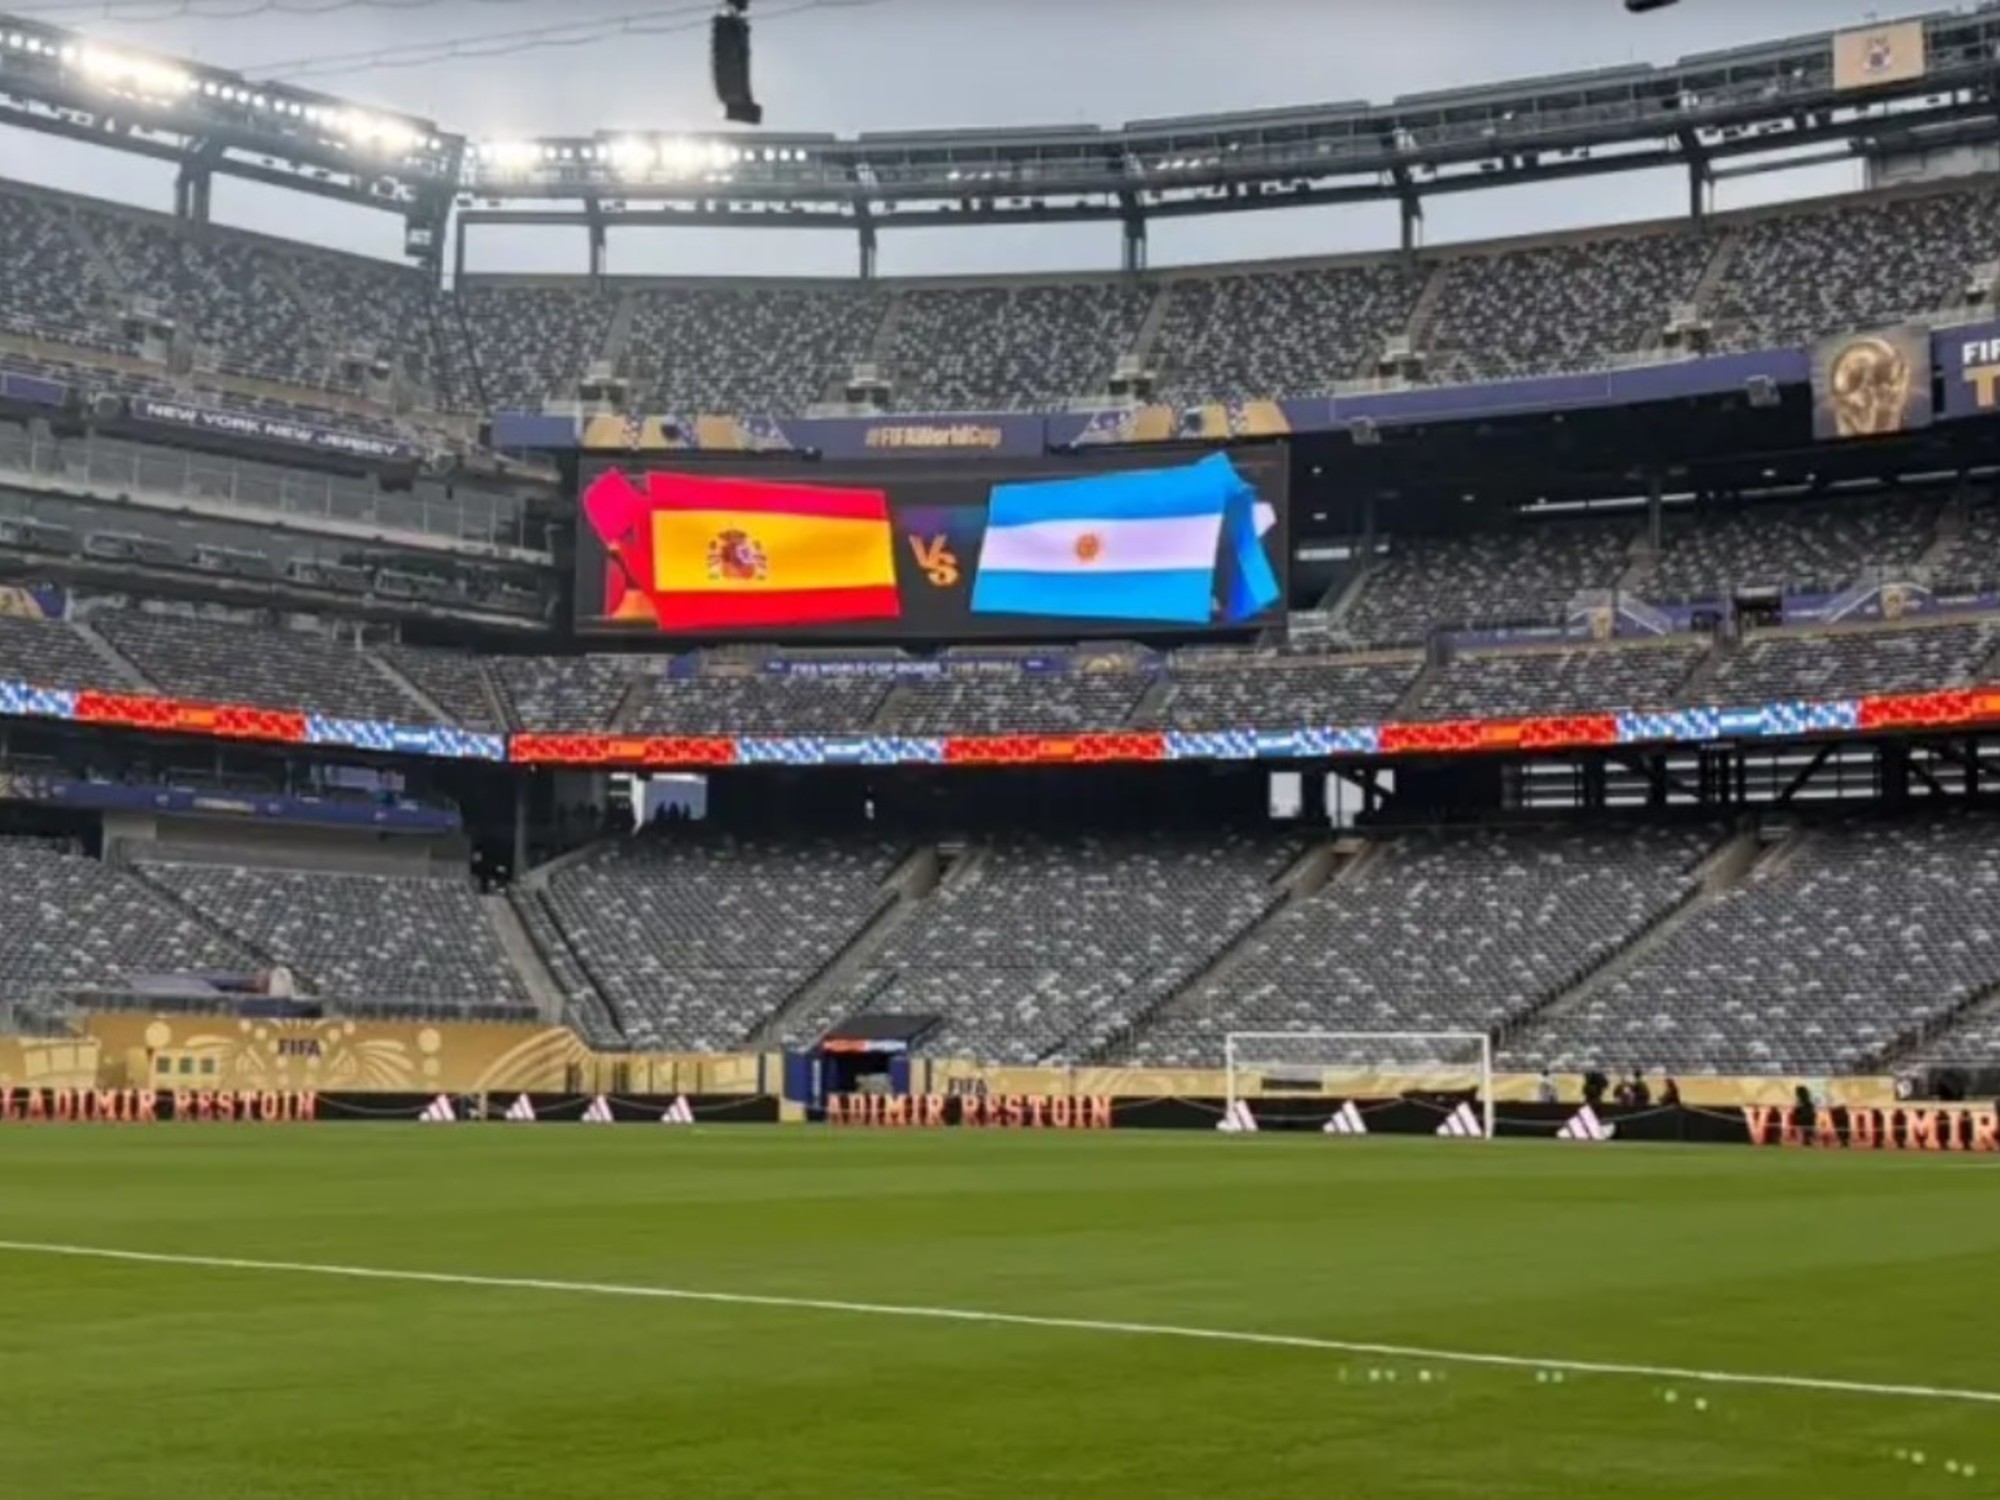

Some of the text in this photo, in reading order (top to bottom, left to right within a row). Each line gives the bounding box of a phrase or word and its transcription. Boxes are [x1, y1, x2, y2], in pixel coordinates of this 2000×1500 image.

[146, 403, 398, 456] NEW YORK NEW JERSEY
[908, 534, 958, 586] VS
[279, 1038, 321, 1057] FIFA
[948, 1077, 989, 1095] FIFA
[174, 1090, 317, 1122] RESTOIN
[961, 1094, 1111, 1128] RESTOIN
[1741, 1106, 2000, 1150] VLADIMIR
